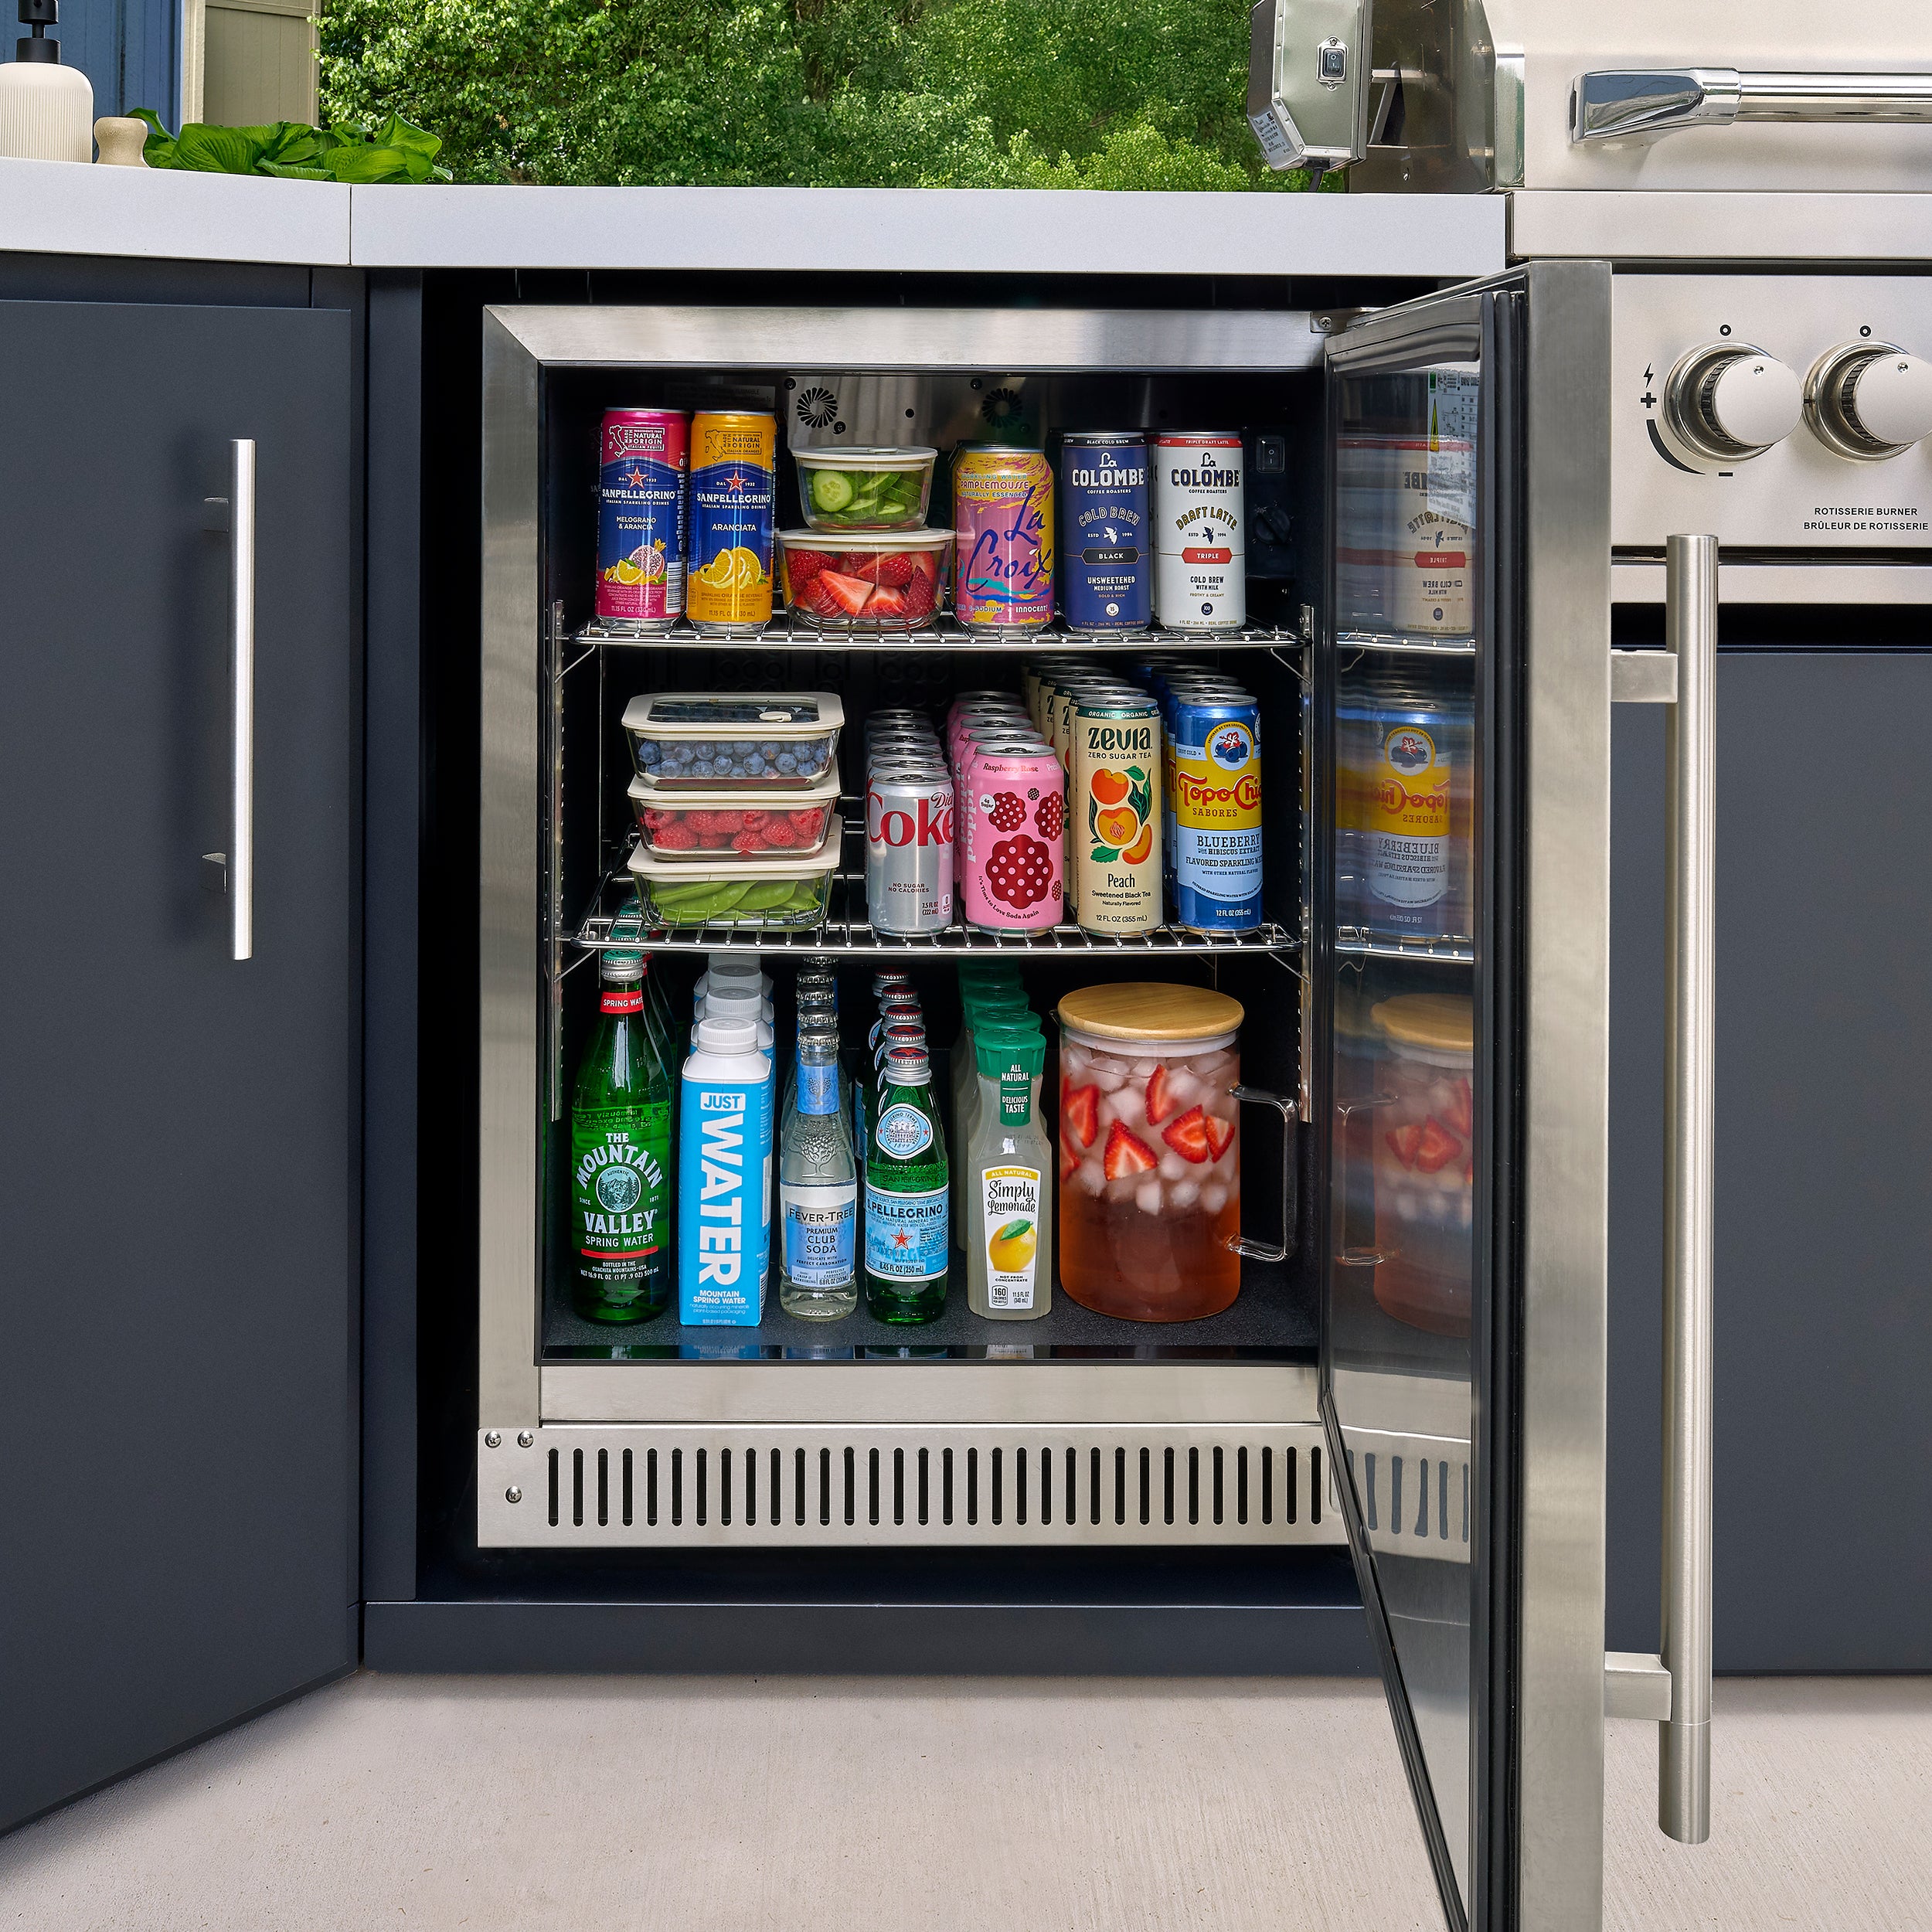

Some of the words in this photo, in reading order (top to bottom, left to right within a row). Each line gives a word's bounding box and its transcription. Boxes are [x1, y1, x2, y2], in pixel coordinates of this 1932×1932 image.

[1099, 452, 1117, 468] La
[1200, 452, 1216, 468] La
[1072, 468, 1145, 487] COLOMBE
[1171, 469, 1240, 487] COLOMBE
[960, 481, 1029, 490] PAMPLEMOUSSE
[602, 488, 675, 500] SANPELLEGRINO
[696, 492, 771, 504] SANPELLEGRINO
[1004, 485, 1046, 545] La
[1078, 506, 1107, 527] COLD
[1110, 506, 1141, 526] BREW
[1814, 507, 1874, 515] ROTISSERIE
[1175, 506, 1208, 531] DRAFT
[1209, 506, 1238, 531] LATTE
[1804, 520, 1851, 530] BRÛLEUR
[1853, 522, 1867, 530] DE
[1869, 522, 1929, 530] ROTISSERIE
[712, 523, 757, 532] ARANCIATA
[966, 529, 1052, 593] Croix
[1087, 576, 1135, 584] UNSWEETENED
[1015, 604, 1048, 613] INNOCENT!
[1088, 727, 1151, 751] zevia
[983, 763, 1020, 773] Raspberry
[1178, 771, 1232, 807] Topo
[930, 791, 954, 809] Diet
[867, 791, 954, 847] Coke
[1192, 807, 1237, 818] SABORES
[967, 788, 977, 863] poppi
[1197, 833, 1260, 848] BLUEBERRY
[1185, 856, 1219, 867] FLAVORED
[1219, 856, 1255, 867] SPARKLING
[1107, 873, 1135, 888] Peach
[1091, 890, 1124, 899] Sweetened
[981, 885, 989, 901] Time
[992, 904, 1006, 916] Love
[1022, 910, 1039, 920] Again
[603, 998, 628, 1007] SPRING
[1010, 1064, 1022, 1073] ALL
[1001, 1072, 1029, 1082] NATURAL
[703, 1094, 740, 1109] JUST
[1002, 1096, 1029, 1104] DELICIOUS
[1005, 1104, 1025, 1113] TASTE
[605, 1132, 629, 1143] THE
[577, 1144, 663, 1190] MOUNTAIN
[988, 1179, 1036, 1203] Simply
[699, 1112, 743, 1286] WATER
[987, 1199, 1036, 1216] Lemonade
[789, 1206, 854, 1223] FEVER-TREE
[583, 1209, 655, 1234] VALLEY
[585, 1235, 619, 1247] SPRING
[623, 1233, 654, 1247] WATER
[808, 1235, 836, 1244] CLUB
[806, 1245, 837, 1253] SODA
[612, 1264, 647, 1274] MOUNTAINS-USA
[889, 1264, 895, 1273] FL
[903, 1265, 915, 1274] (250
[994, 1287, 1006, 1296] 160
[693, 1296, 721, 1304] SPRING
